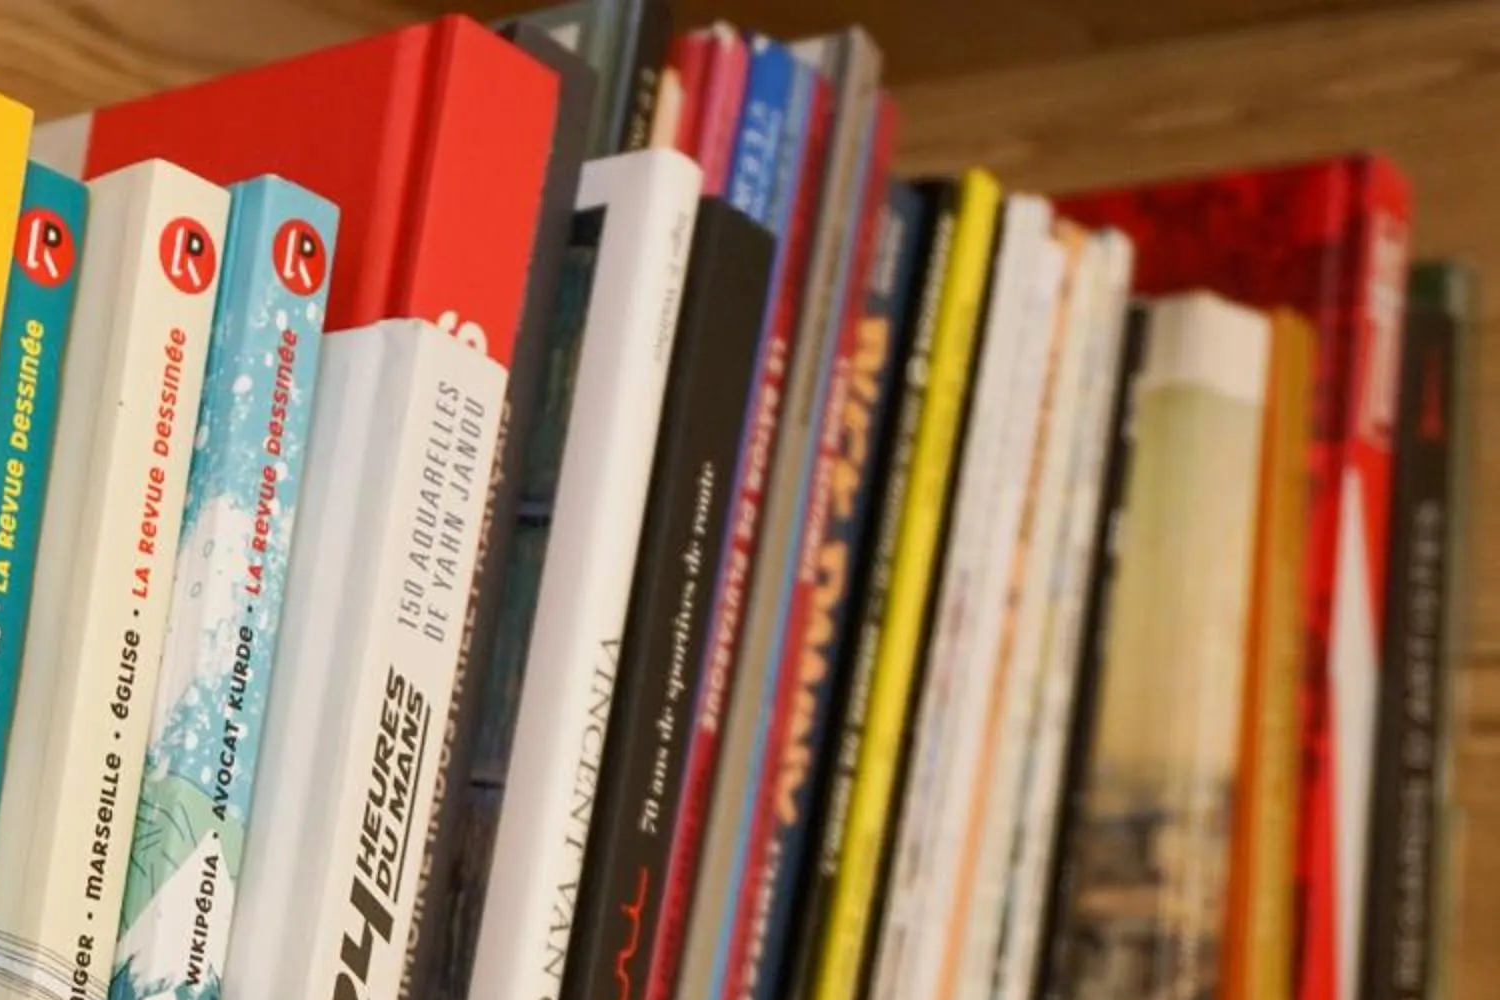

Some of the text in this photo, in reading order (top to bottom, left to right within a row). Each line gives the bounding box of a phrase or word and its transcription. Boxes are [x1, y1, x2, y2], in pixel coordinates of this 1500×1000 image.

[131, 567, 151, 599] LA
[396, 380, 460, 631] 150 AQUARELLES
[423, 608, 449, 643] DE
[447, 395, 485, 502] JANOU
[211, 720, 241, 821] AVOCAT
[244, 565, 263, 596] LA
[566, 638, 621, 850] VINCENT
[640, 461, 716, 836] 70 ans de sportives de route
[356, 665, 406, 880] HEURES
[375, 681, 424, 899] DU MANS
[543, 882, 577, 979] VAN
